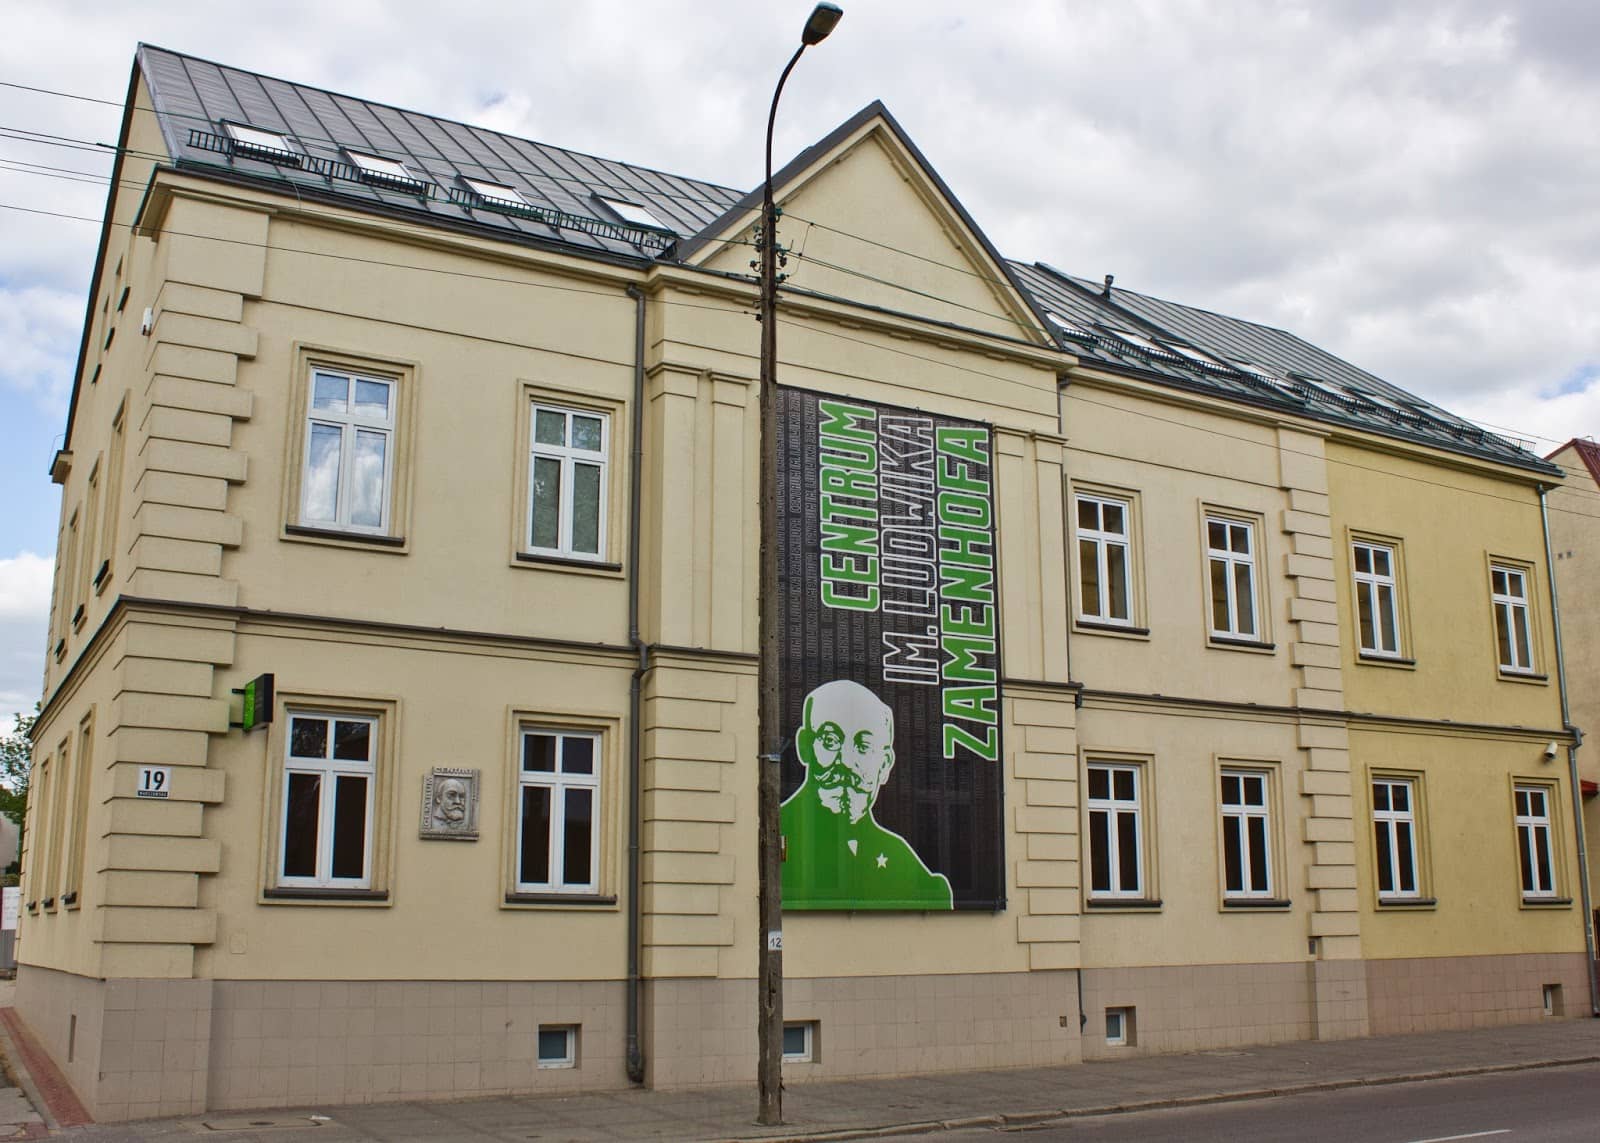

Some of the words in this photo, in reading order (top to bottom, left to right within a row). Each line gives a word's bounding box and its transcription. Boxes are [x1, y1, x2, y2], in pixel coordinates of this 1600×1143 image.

[819, 400, 880, 613] CENTRUM
[879, 415, 938, 617] LUDWIKA
[882, 625, 940, 686] IM.
[937, 428, 999, 761] ZAMENHOFA
[143, 770, 165, 791] 19
[770, 935, 782, 948] 12
